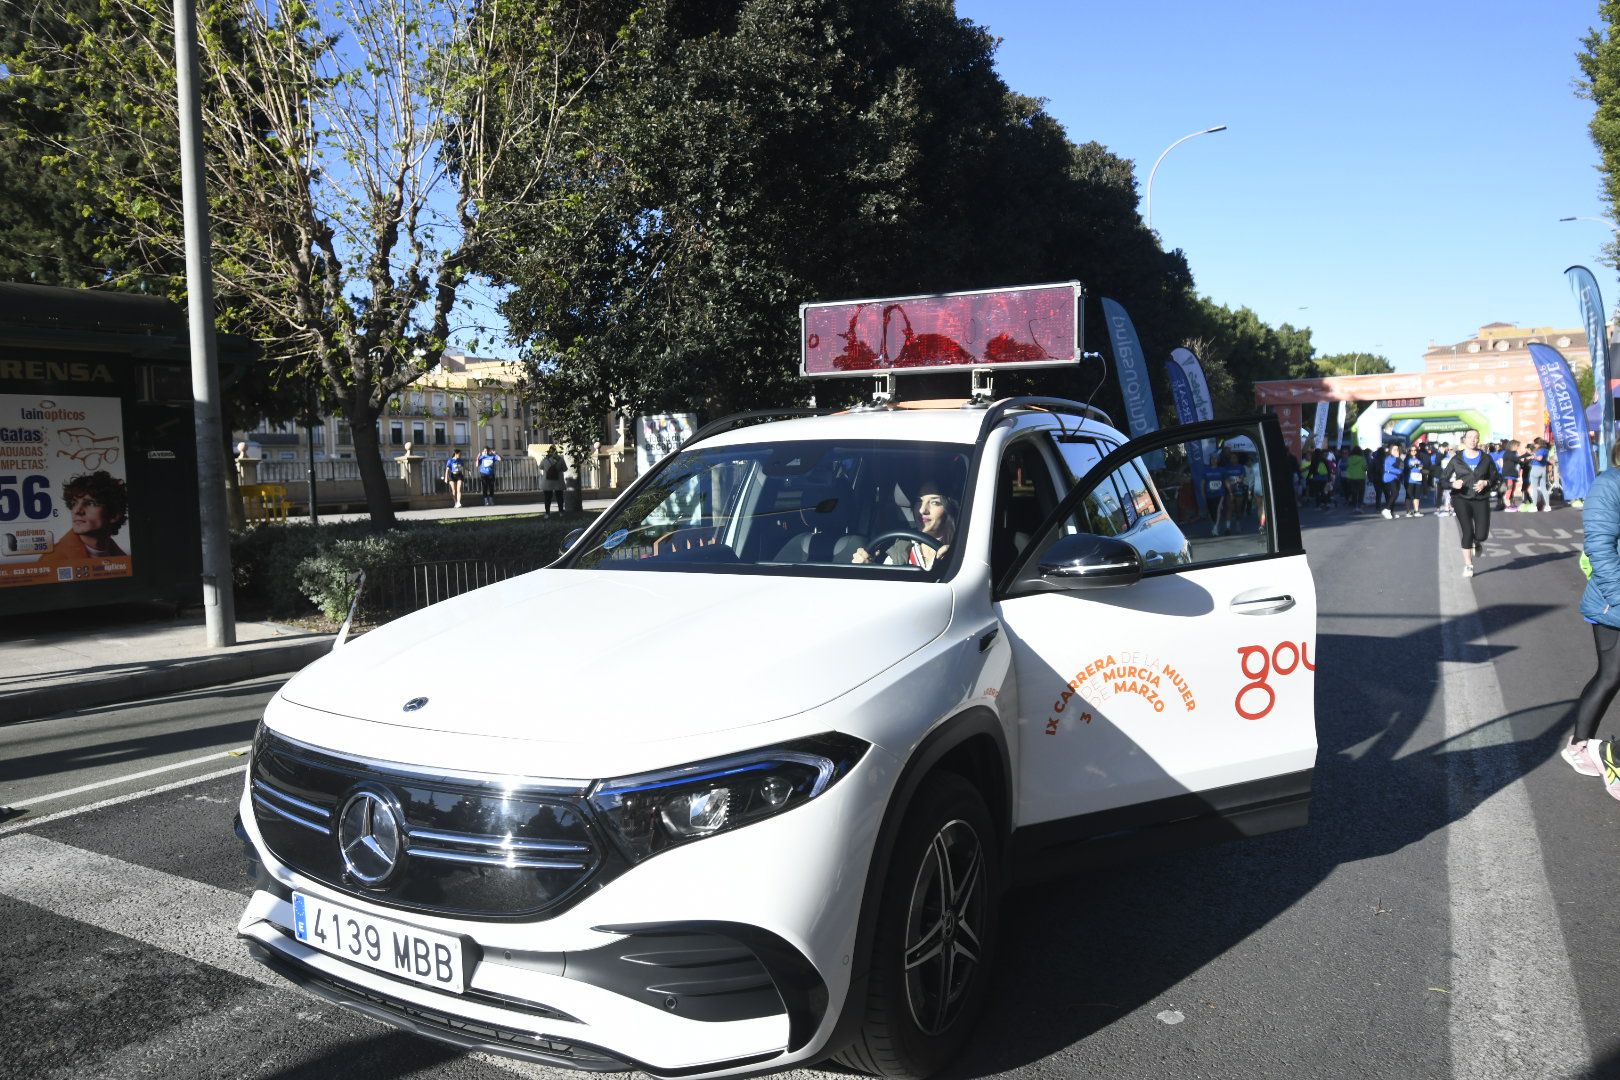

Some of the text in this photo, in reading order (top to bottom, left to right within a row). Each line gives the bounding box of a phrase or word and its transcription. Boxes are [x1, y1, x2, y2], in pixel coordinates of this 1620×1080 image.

[20, 407, 86, 422] lainopticos
[0, 427, 42, 442] Gafas
[1488, 528, 1584, 539] BU
[1103, 666, 1161, 688] MURCIA
[1045, 718, 1060, 736] IX
[1054, 654, 1117, 714] CARRERA
[1162, 663, 1196, 713] MUJER
[1080, 712, 1092, 724] 3
[1114, 680, 1165, 713] MARZO
[314, 908, 381, 962] 4139
[392, 931, 453, 983] MBB
